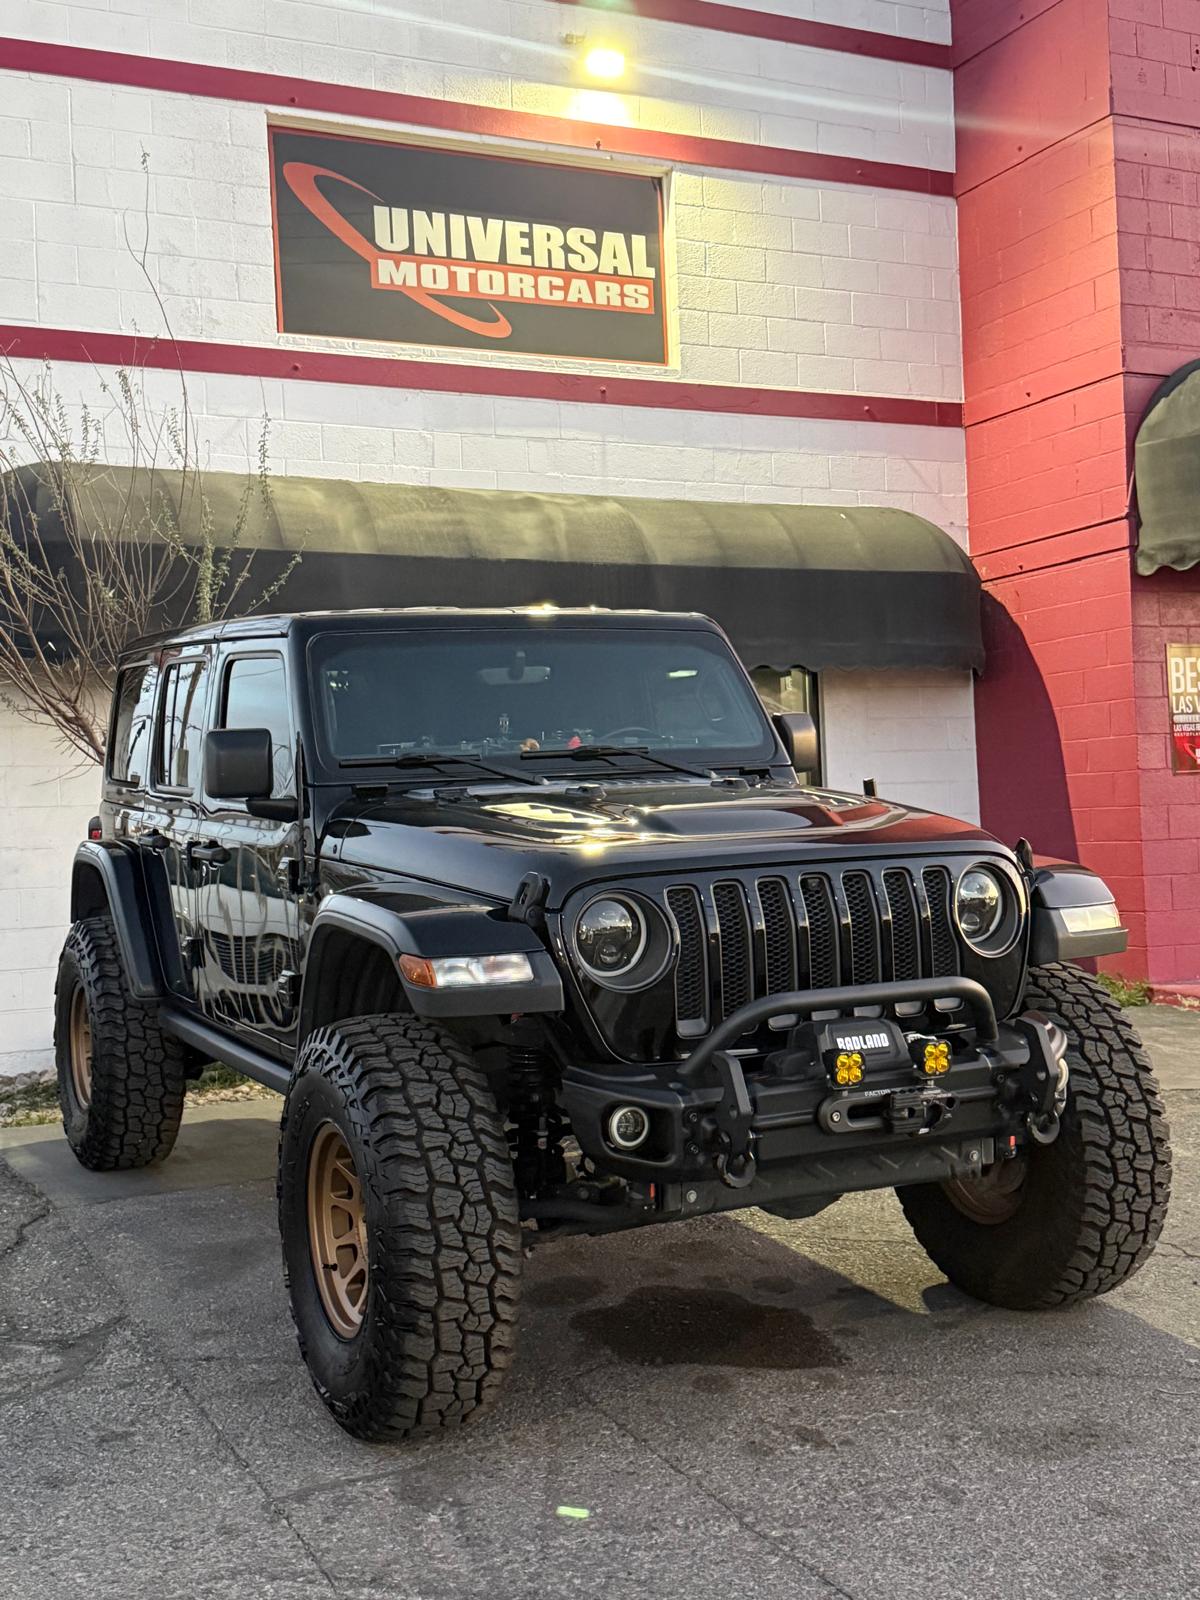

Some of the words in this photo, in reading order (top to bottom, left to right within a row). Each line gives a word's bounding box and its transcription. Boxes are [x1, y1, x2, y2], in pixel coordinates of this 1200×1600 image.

[373, 205, 656, 279] UNIVERSAL
[377, 258, 650, 310] MOTORCARS
[1170, 657, 1200, 694] BE
[1173, 695, 1193, 714] LAS
